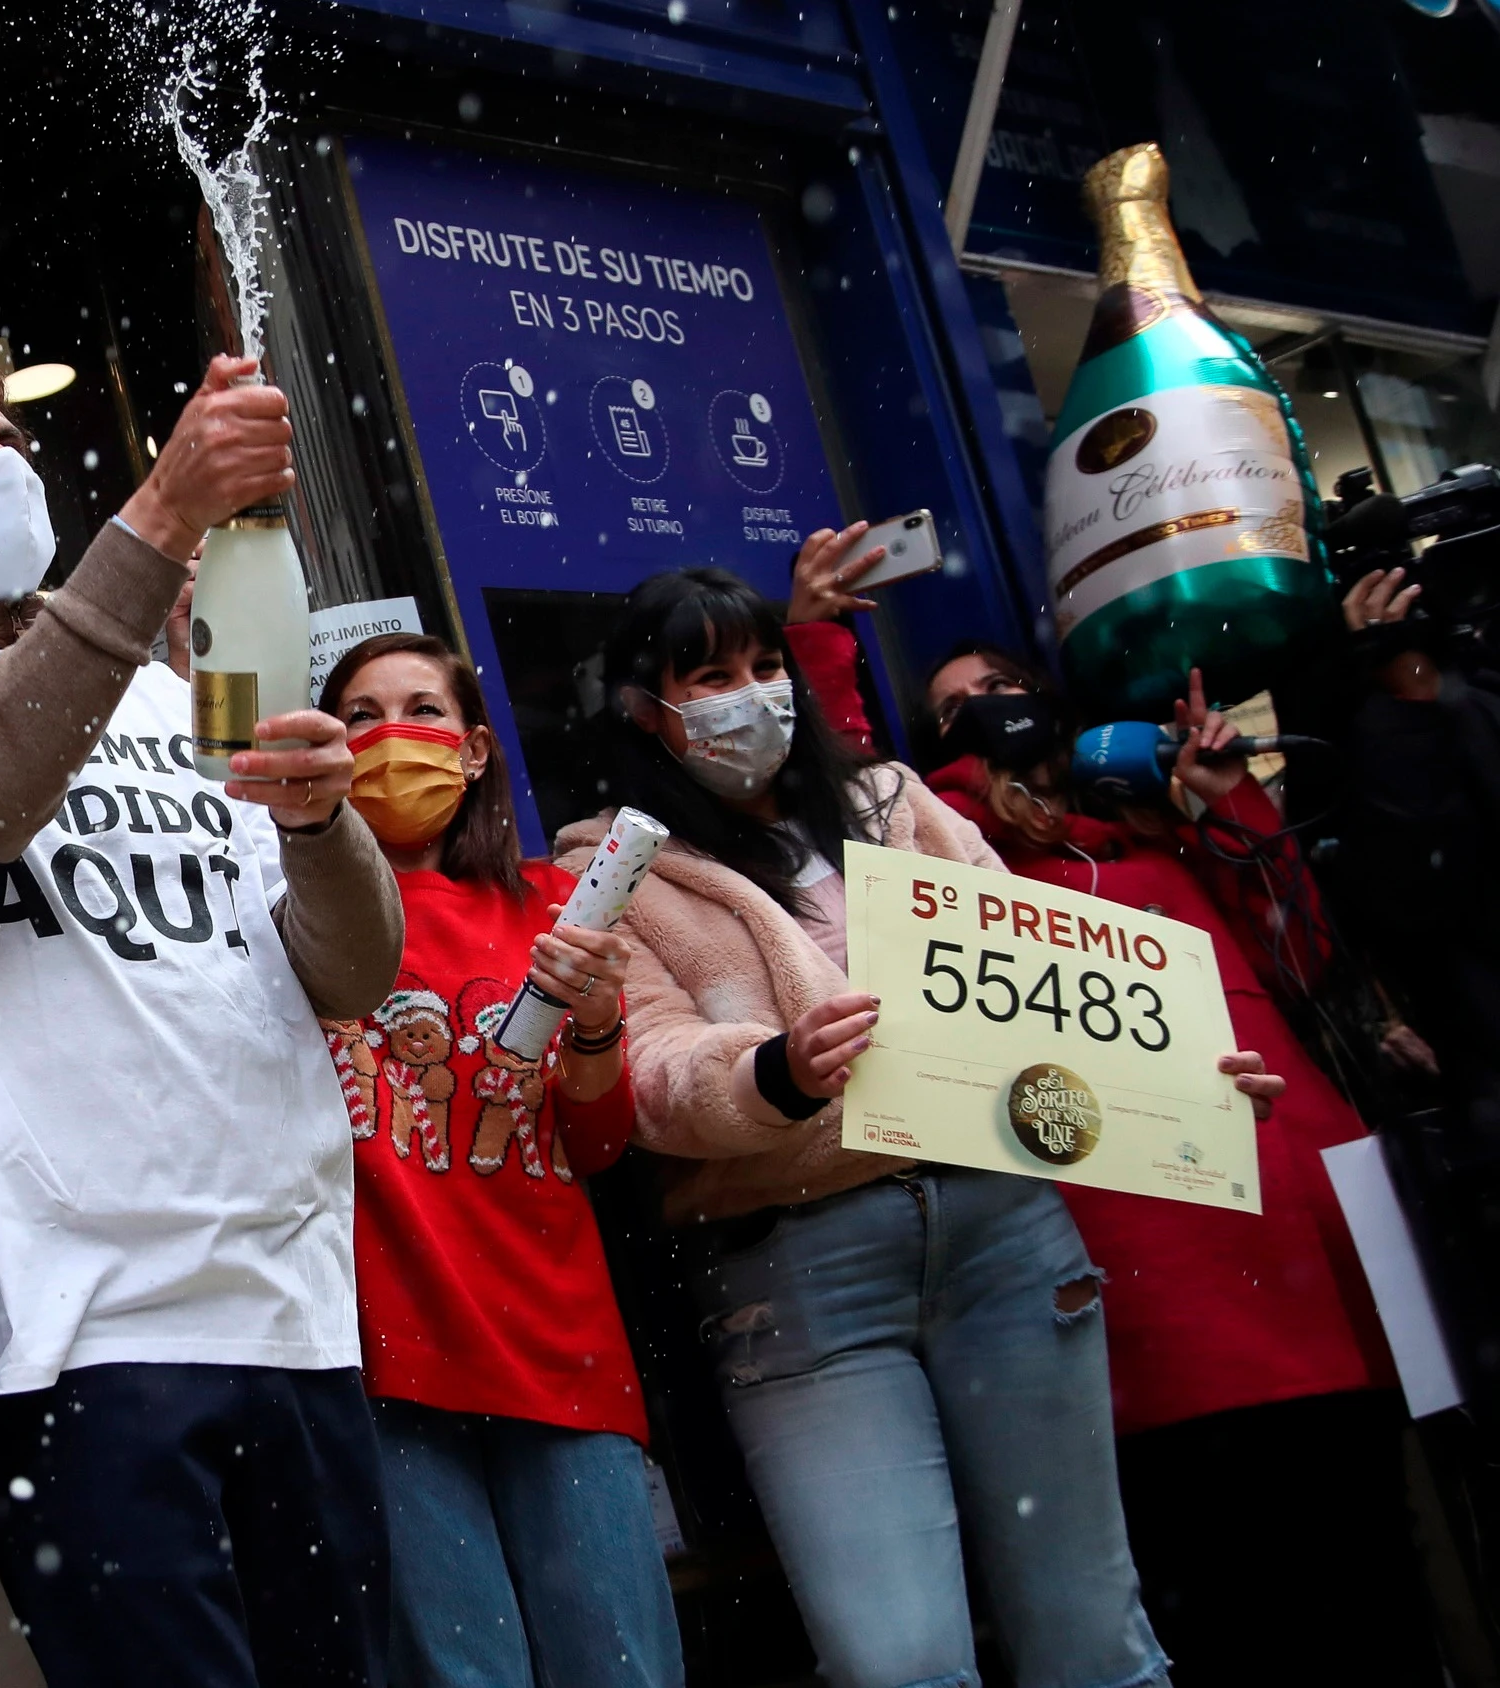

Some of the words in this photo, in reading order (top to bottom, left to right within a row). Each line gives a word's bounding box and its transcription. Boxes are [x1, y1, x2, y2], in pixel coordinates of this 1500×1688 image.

[394, 217, 551, 273] DISFRUTE
[553, 241, 597, 279] DE
[600, 247, 642, 286] SU
[644, 254, 754, 302] TIEMPO
[510, 290, 555, 329] EN
[557, 296, 581, 332] 3
[584, 300, 685, 345] PASOS
[495, 487, 553, 505] PRESIONE
[631, 497, 669, 513] RETIRE
[500, 509, 516, 523] EL
[742, 506, 793, 523] DISFRUTE
[627, 517, 644, 532] SU
[644, 518, 683, 534] TURNO
[743, 526, 759, 541] SU
[910, 878, 958, 920] 5º
[977, 892, 1168, 972] PREMIO
[921, 938, 1171, 1052] 55483
[881, 1136, 922, 1149] NACIONAL
[882, 1128, 914, 1140] LOTERÍA
